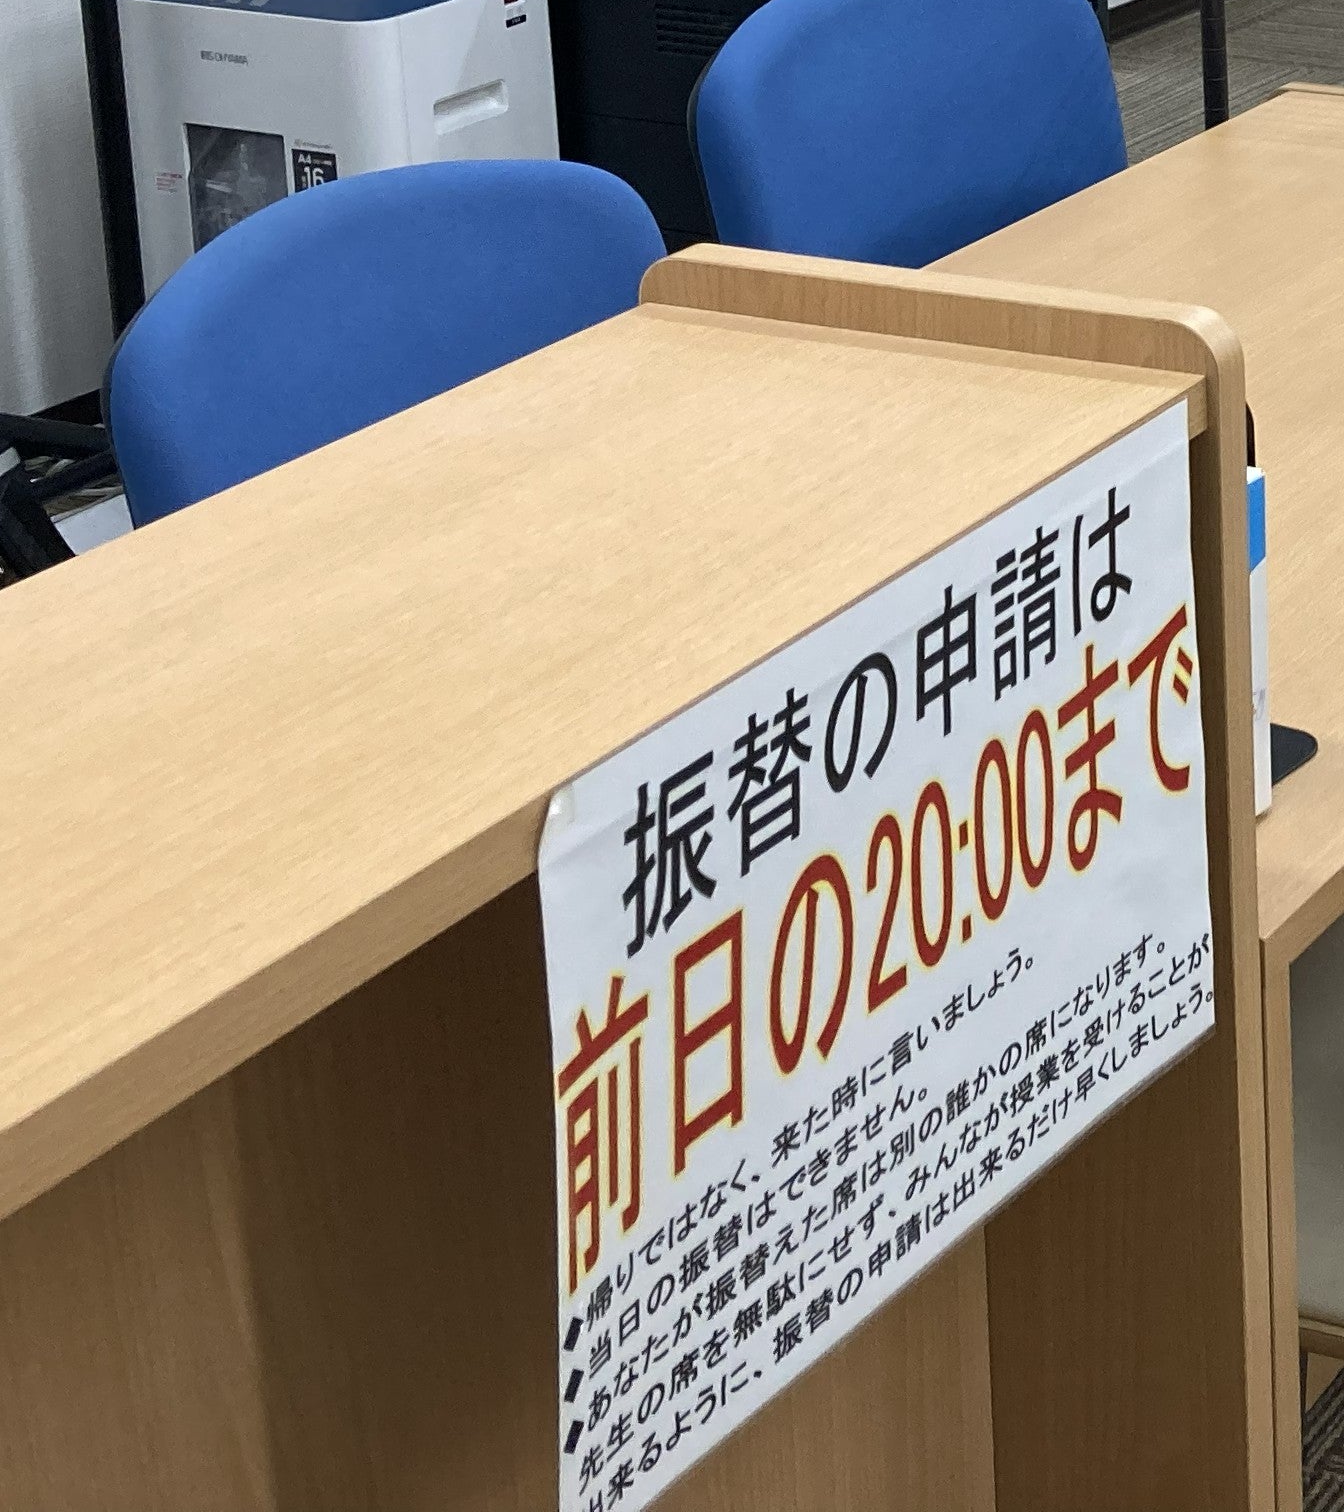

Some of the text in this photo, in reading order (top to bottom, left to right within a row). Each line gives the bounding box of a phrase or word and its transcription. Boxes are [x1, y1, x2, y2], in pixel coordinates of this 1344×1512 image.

[298, 153, 311, 165] A4
[621, 487, 1132, 958] 振替の申請は
[558, 604, 1194, 1295] 前日の20:00まで
[586, 947, 1033, 1333] 帰りではなく、来た時に言いましょう。
[587, 933, 1166, 1432] あなたが振替えた席は別の誰かの席になります。
[588, 1084, 927, 1379] 当日の振替はできません。
